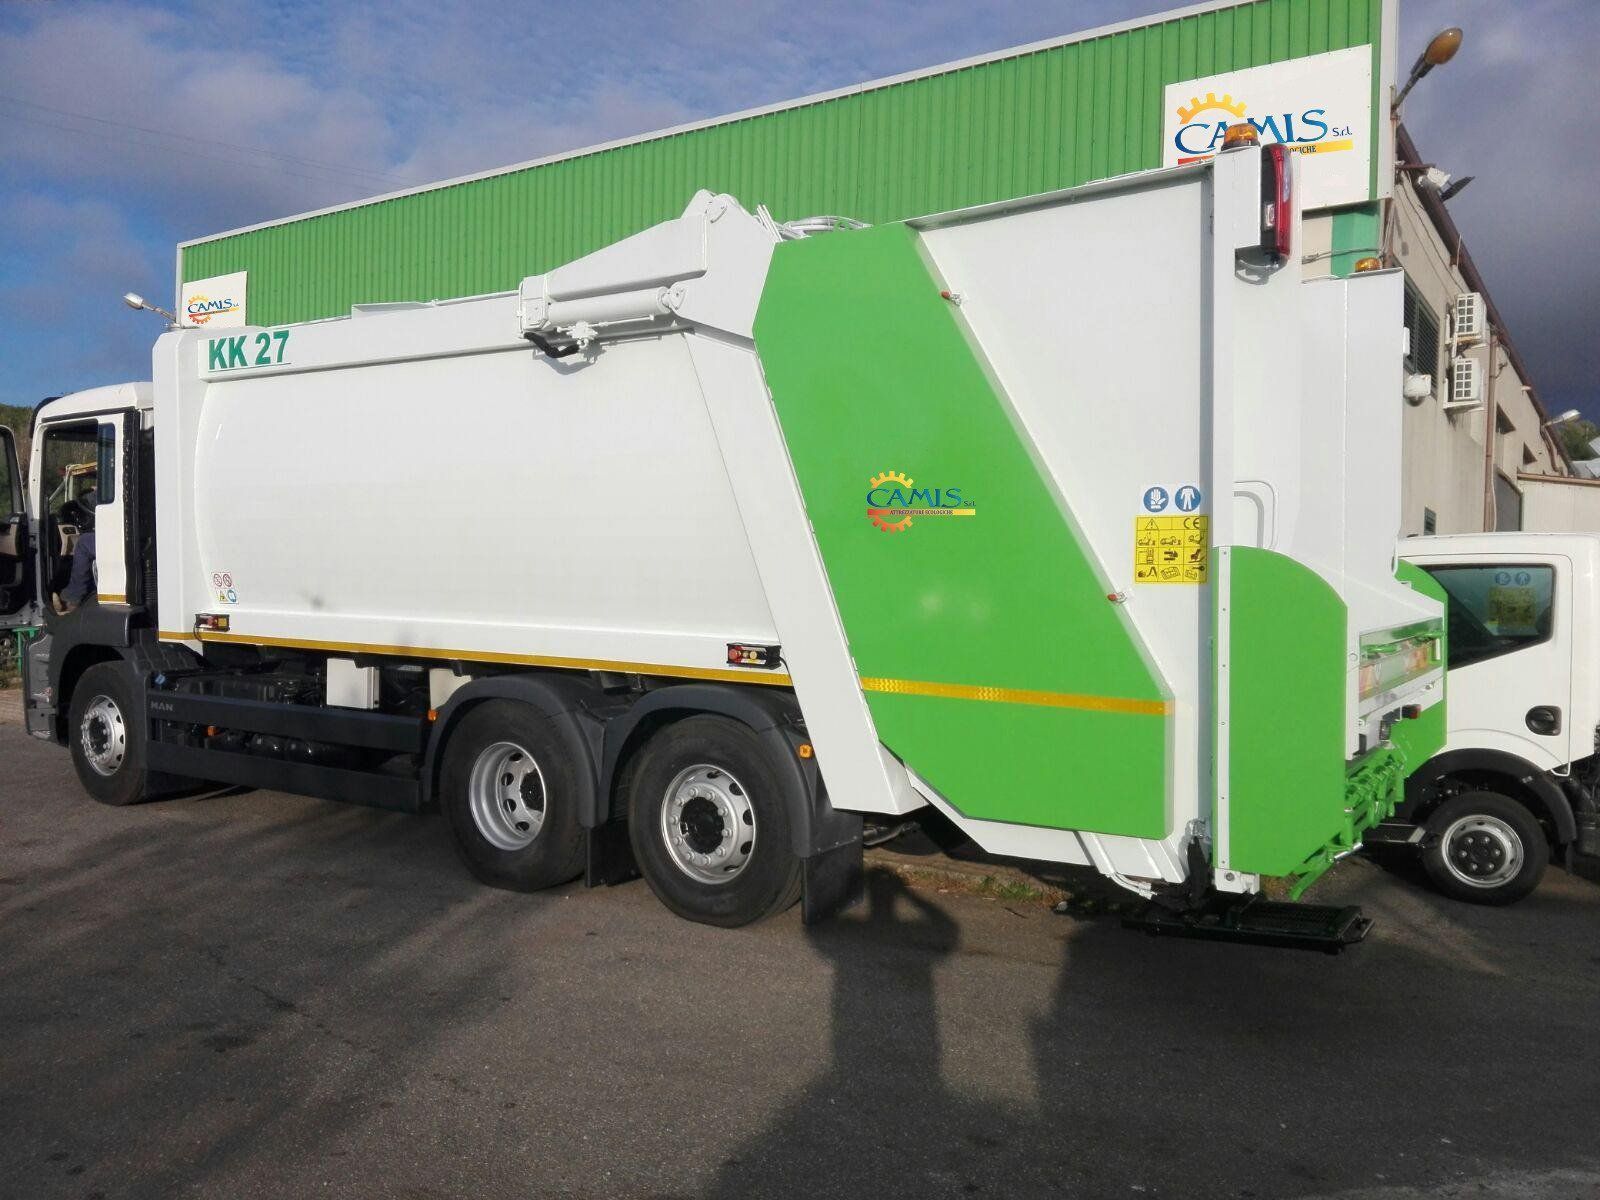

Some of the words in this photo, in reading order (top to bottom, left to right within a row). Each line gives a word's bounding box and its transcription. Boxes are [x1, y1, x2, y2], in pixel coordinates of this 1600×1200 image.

[187, 298, 233, 314] CAMIS
[209, 336, 247, 370] KK
[255, 330, 289, 365] 27
[866, 487, 962, 508] CAMIS
[151, 701, 173, 711] MAN
